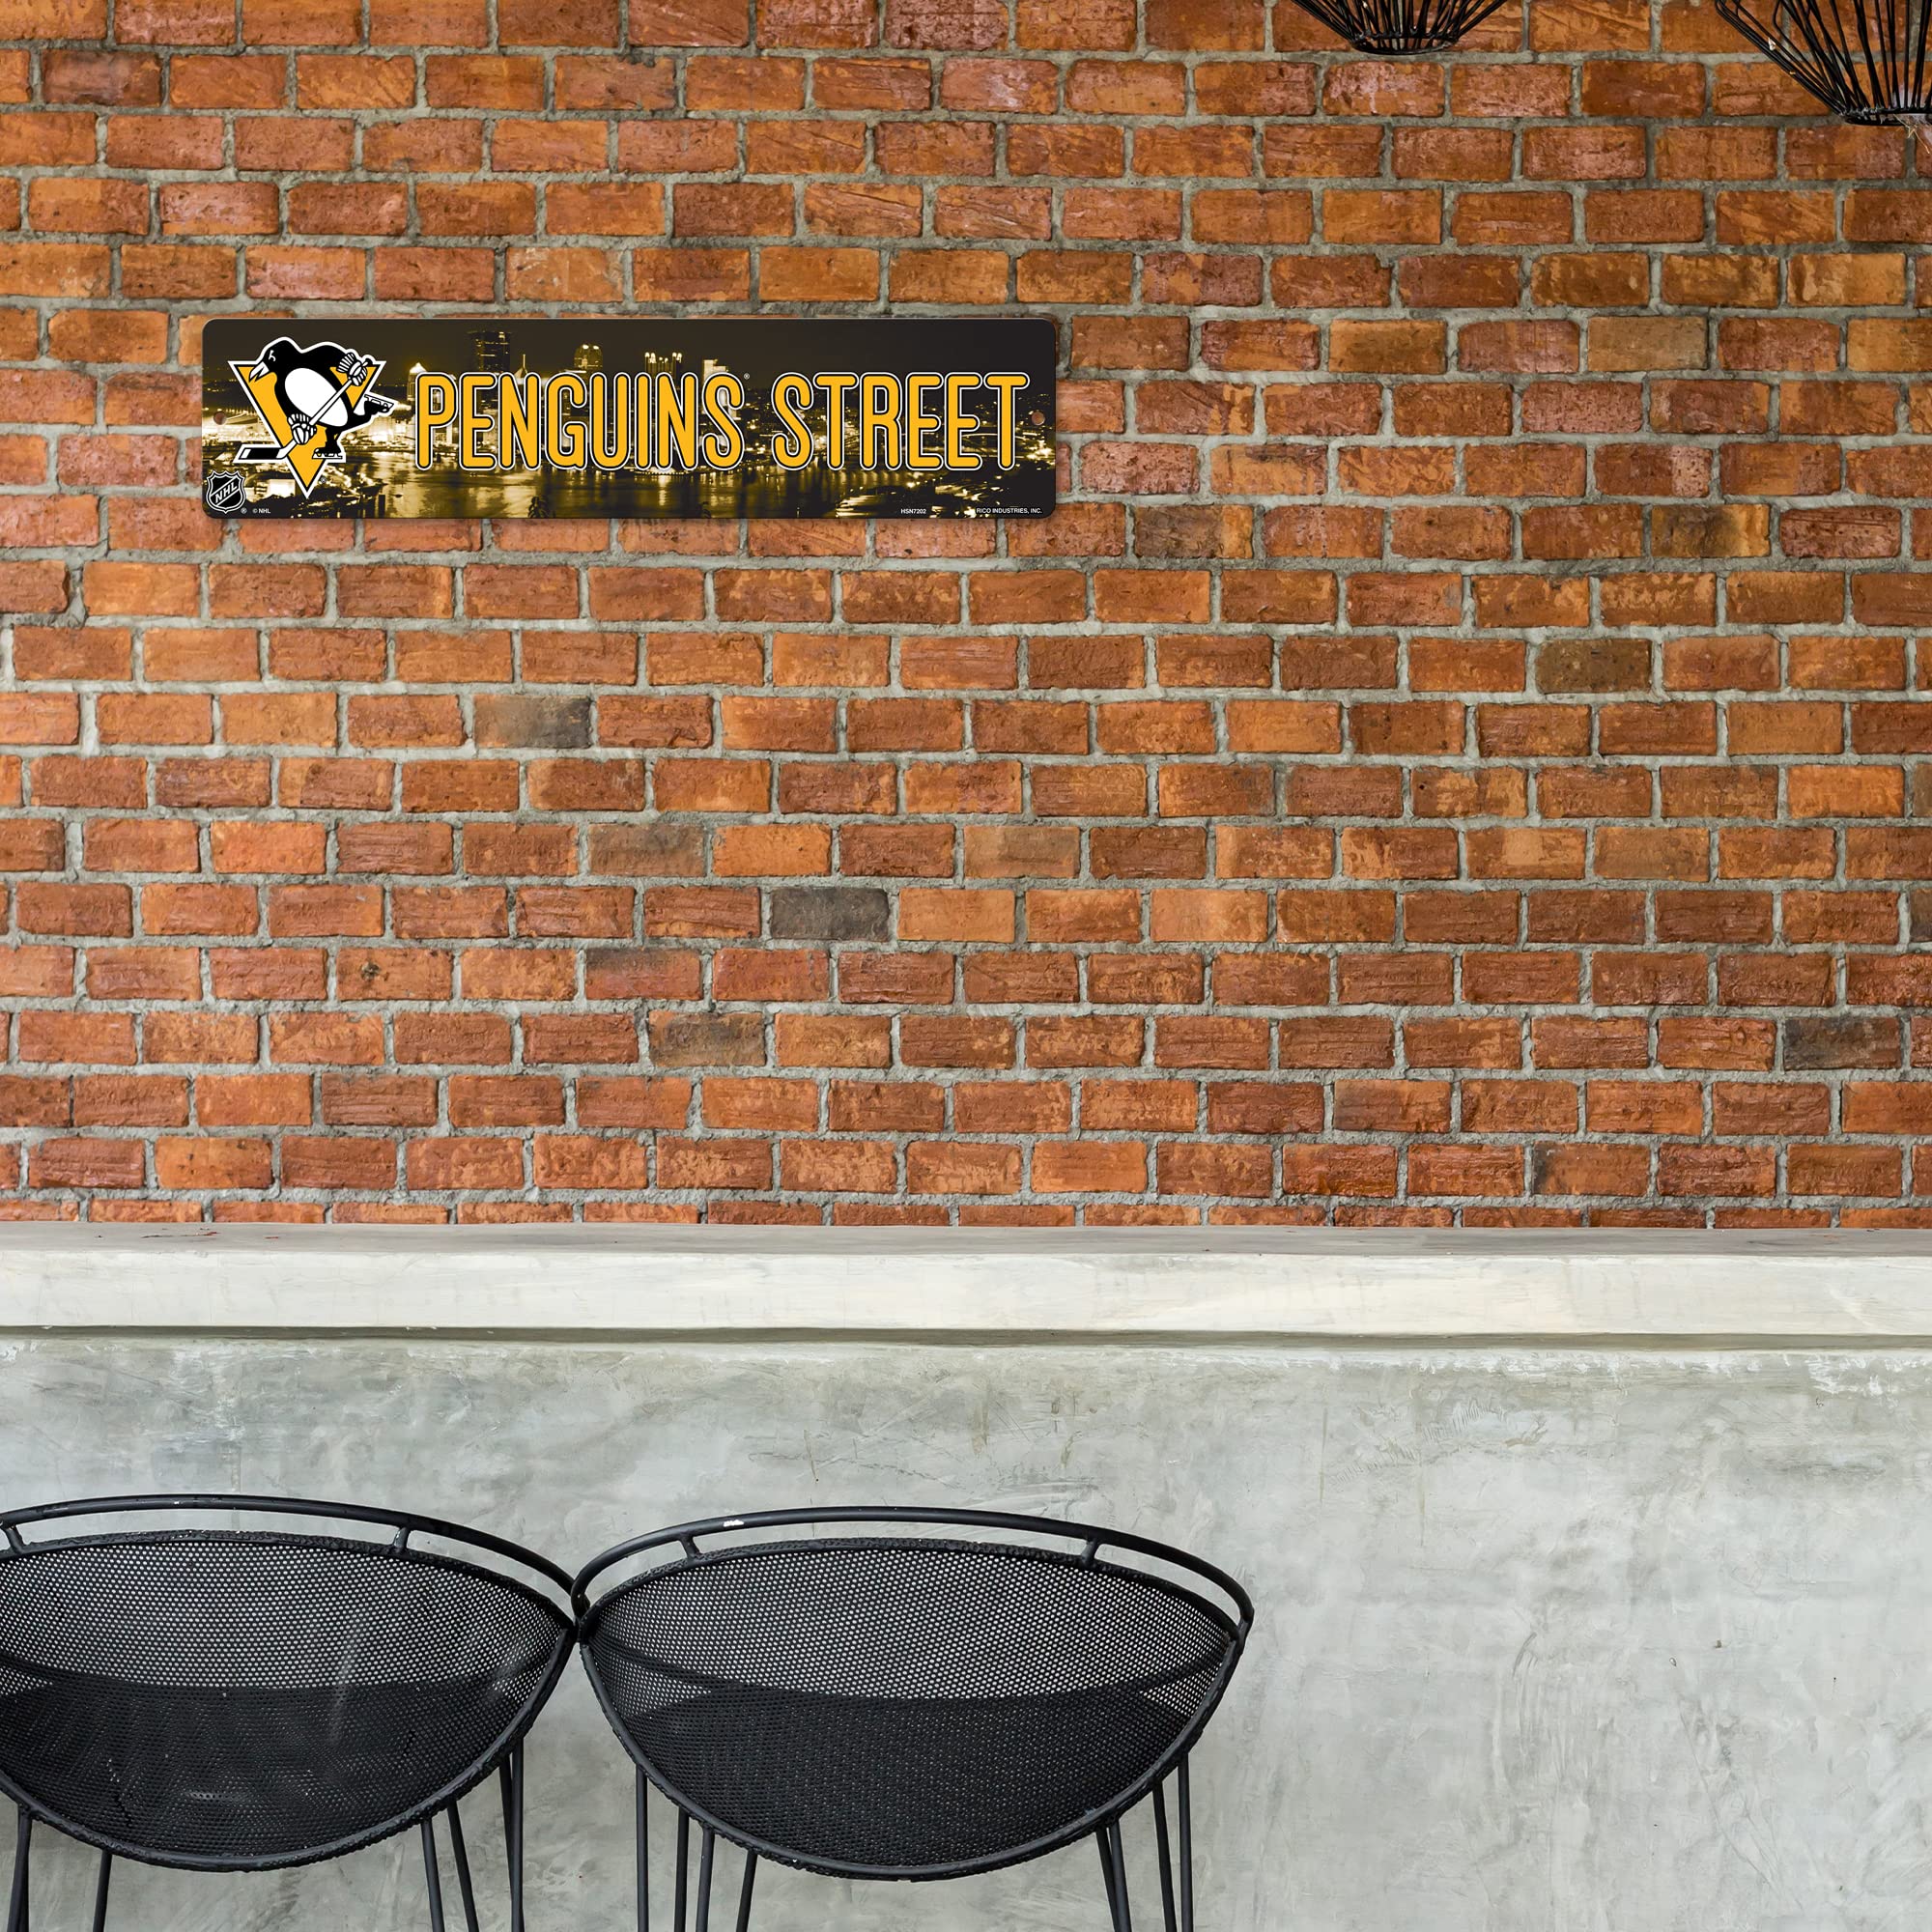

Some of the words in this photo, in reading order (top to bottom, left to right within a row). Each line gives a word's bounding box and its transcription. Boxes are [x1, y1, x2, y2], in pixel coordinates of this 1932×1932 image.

[415, 372, 745, 470] PENGUINS
[771, 372, 1030, 470] STREET
[214, 481, 238, 503] NHL
